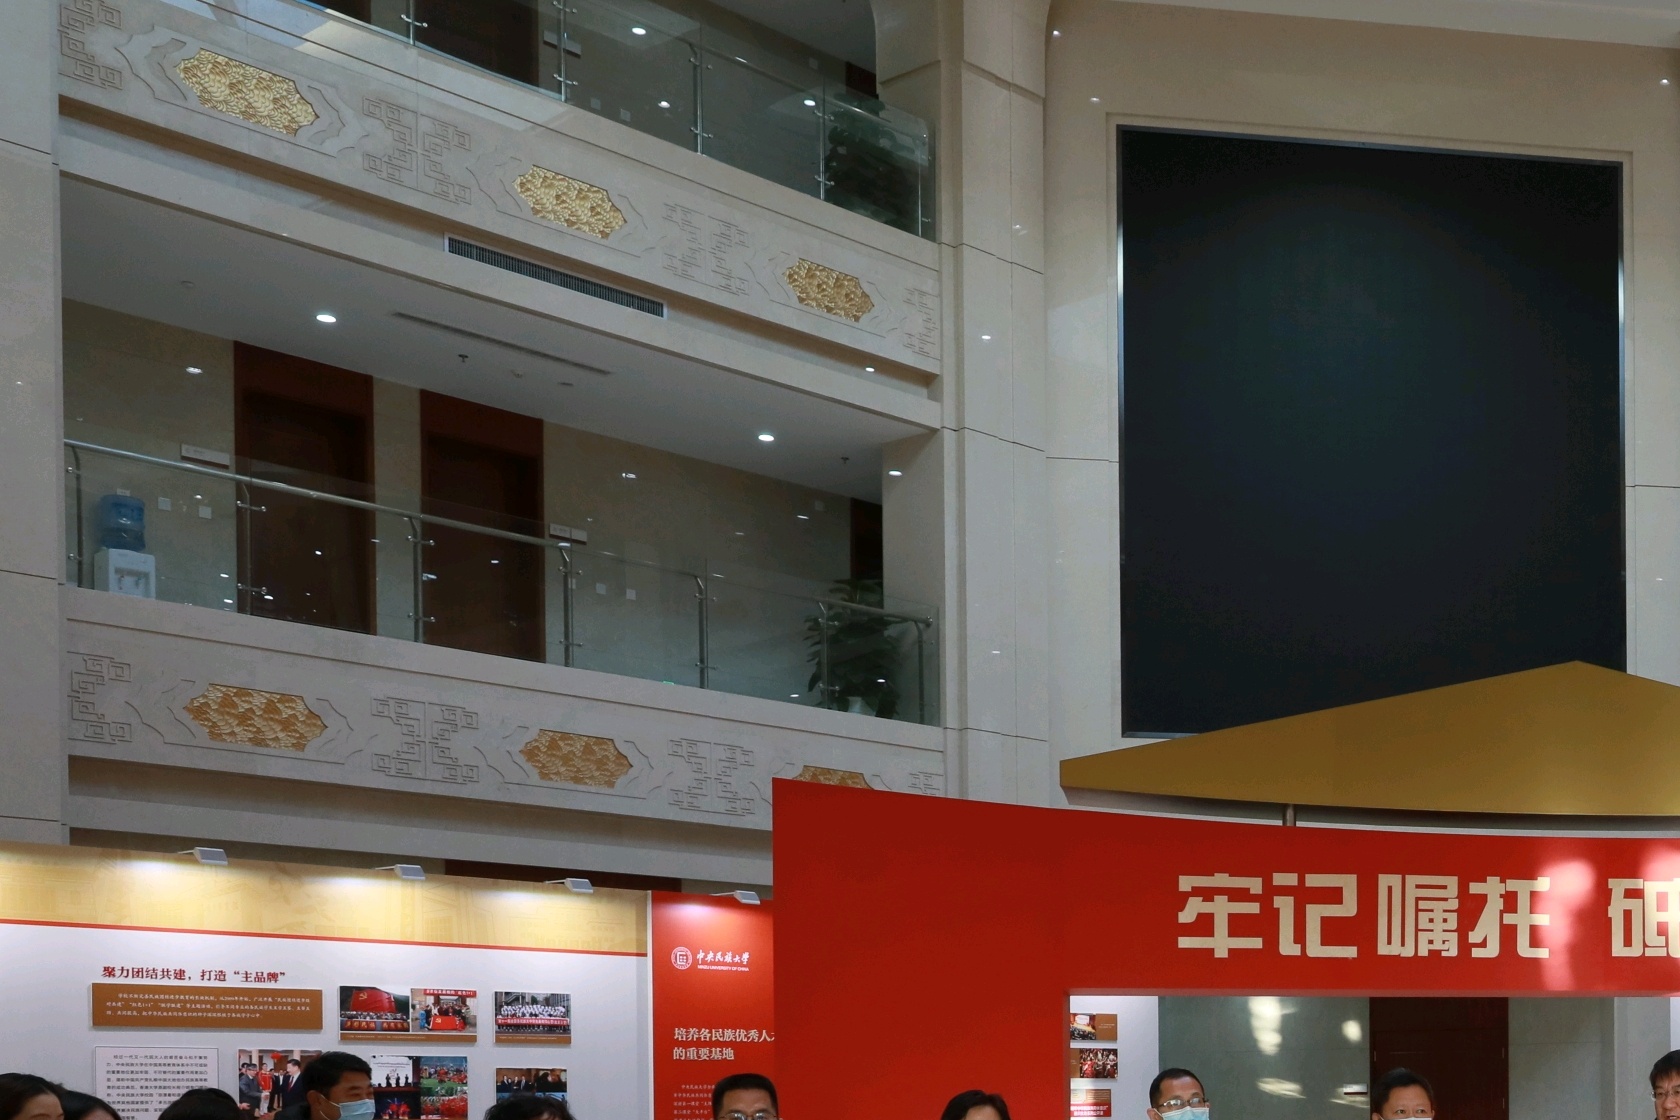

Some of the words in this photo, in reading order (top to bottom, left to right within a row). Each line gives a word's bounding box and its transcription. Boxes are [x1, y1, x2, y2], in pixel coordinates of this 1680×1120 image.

[1177, 872, 1551, 960] 牢记嘱托
[697, 949, 750, 965] 中央民族大学
[101, 965, 286, 983] 聚力团结共建，打造“主品牌”
[673, 1047, 734, 1060] 的重要基地
